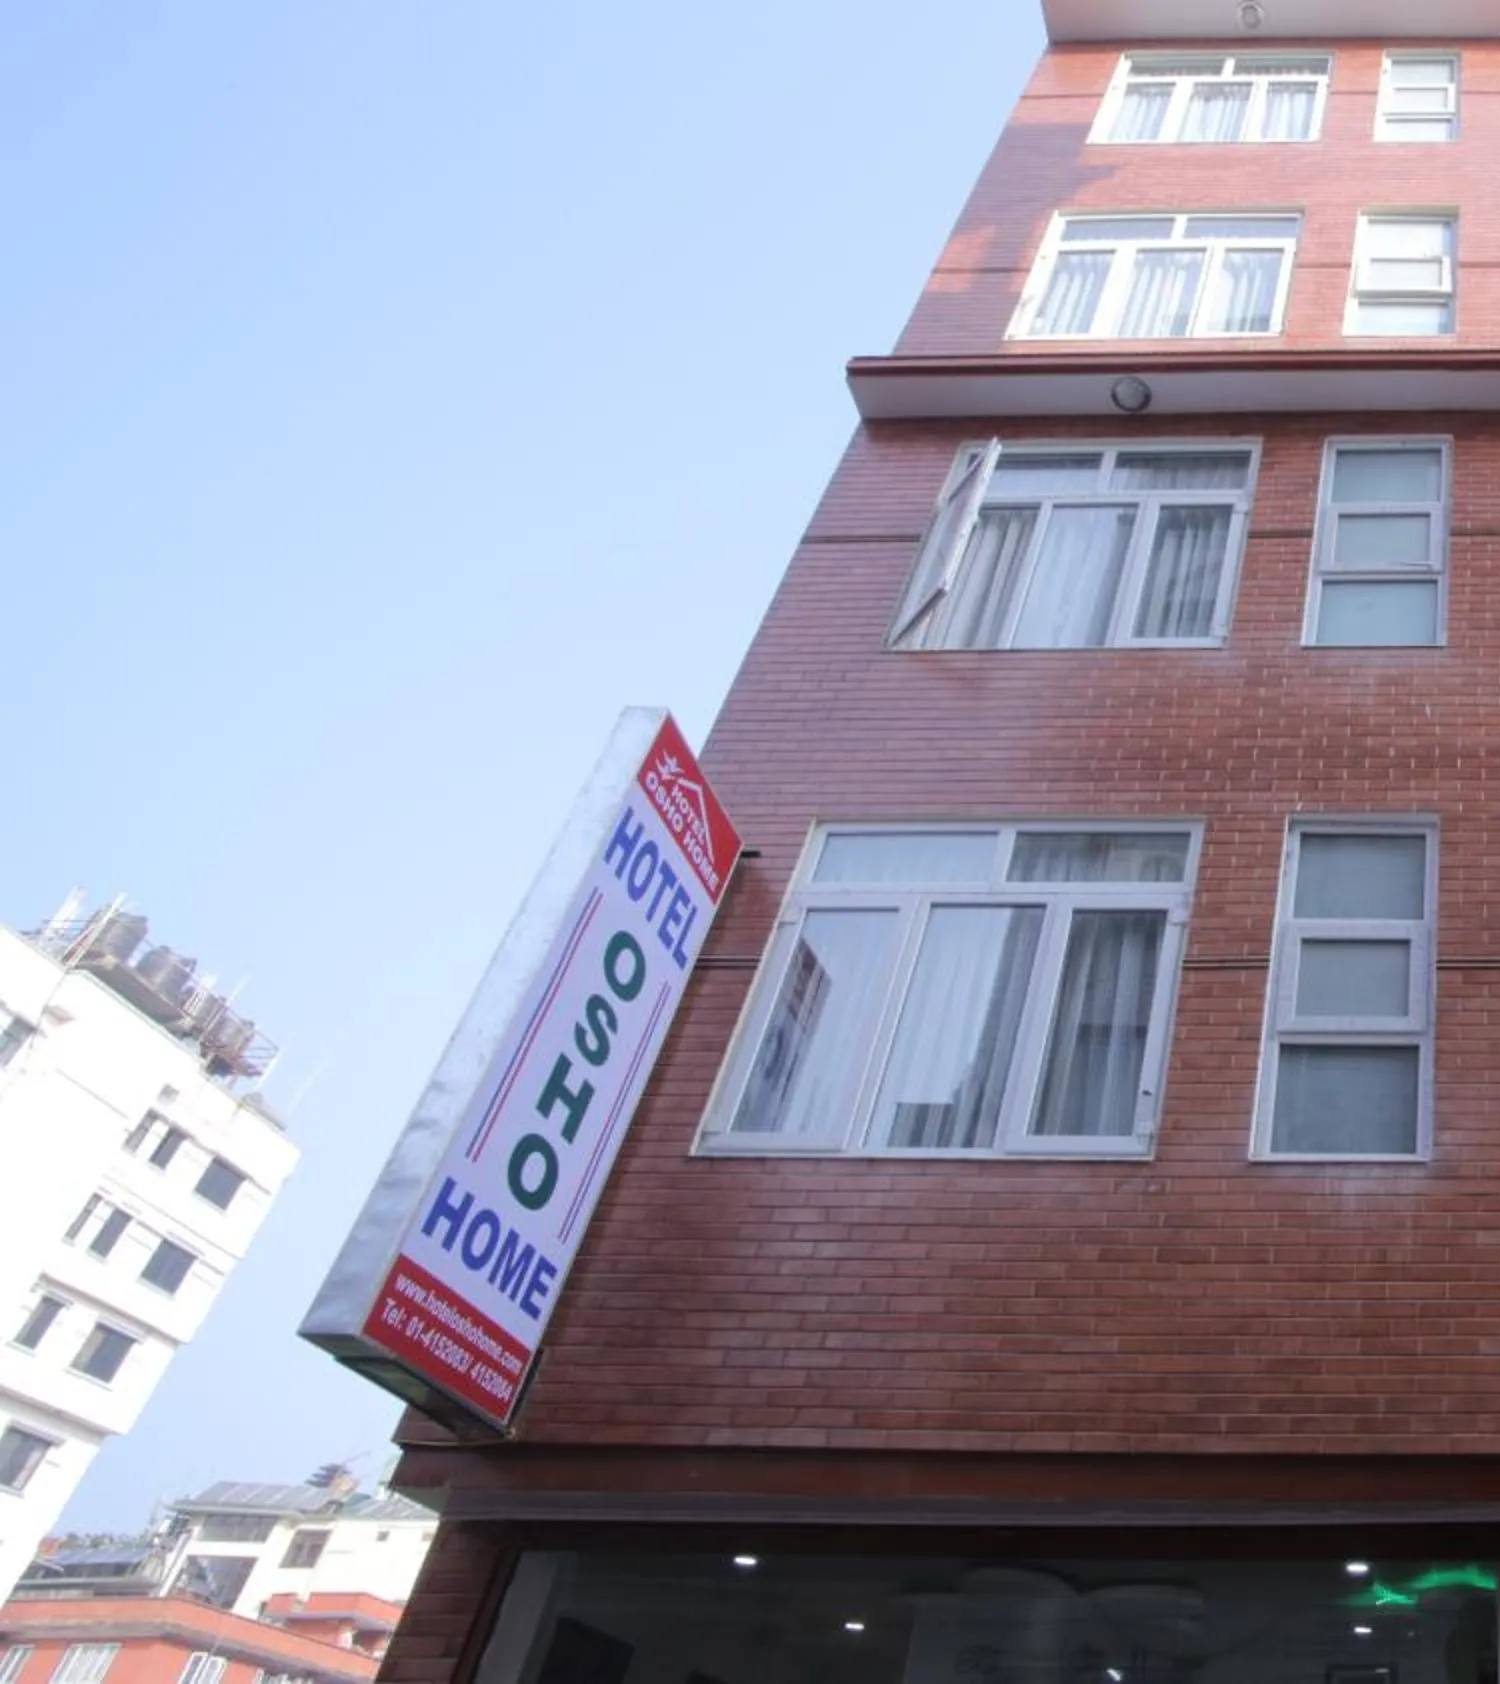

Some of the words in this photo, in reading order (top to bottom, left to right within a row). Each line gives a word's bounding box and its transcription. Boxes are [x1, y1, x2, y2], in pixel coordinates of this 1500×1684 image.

[672, 784, 705, 844] HOTEL
[605, 806, 699, 968] HOTEL
[507, 929, 647, 1211] OSHO
[381, 1297, 407, 1331] Tel:
[421, 1176, 558, 1321] HOME
